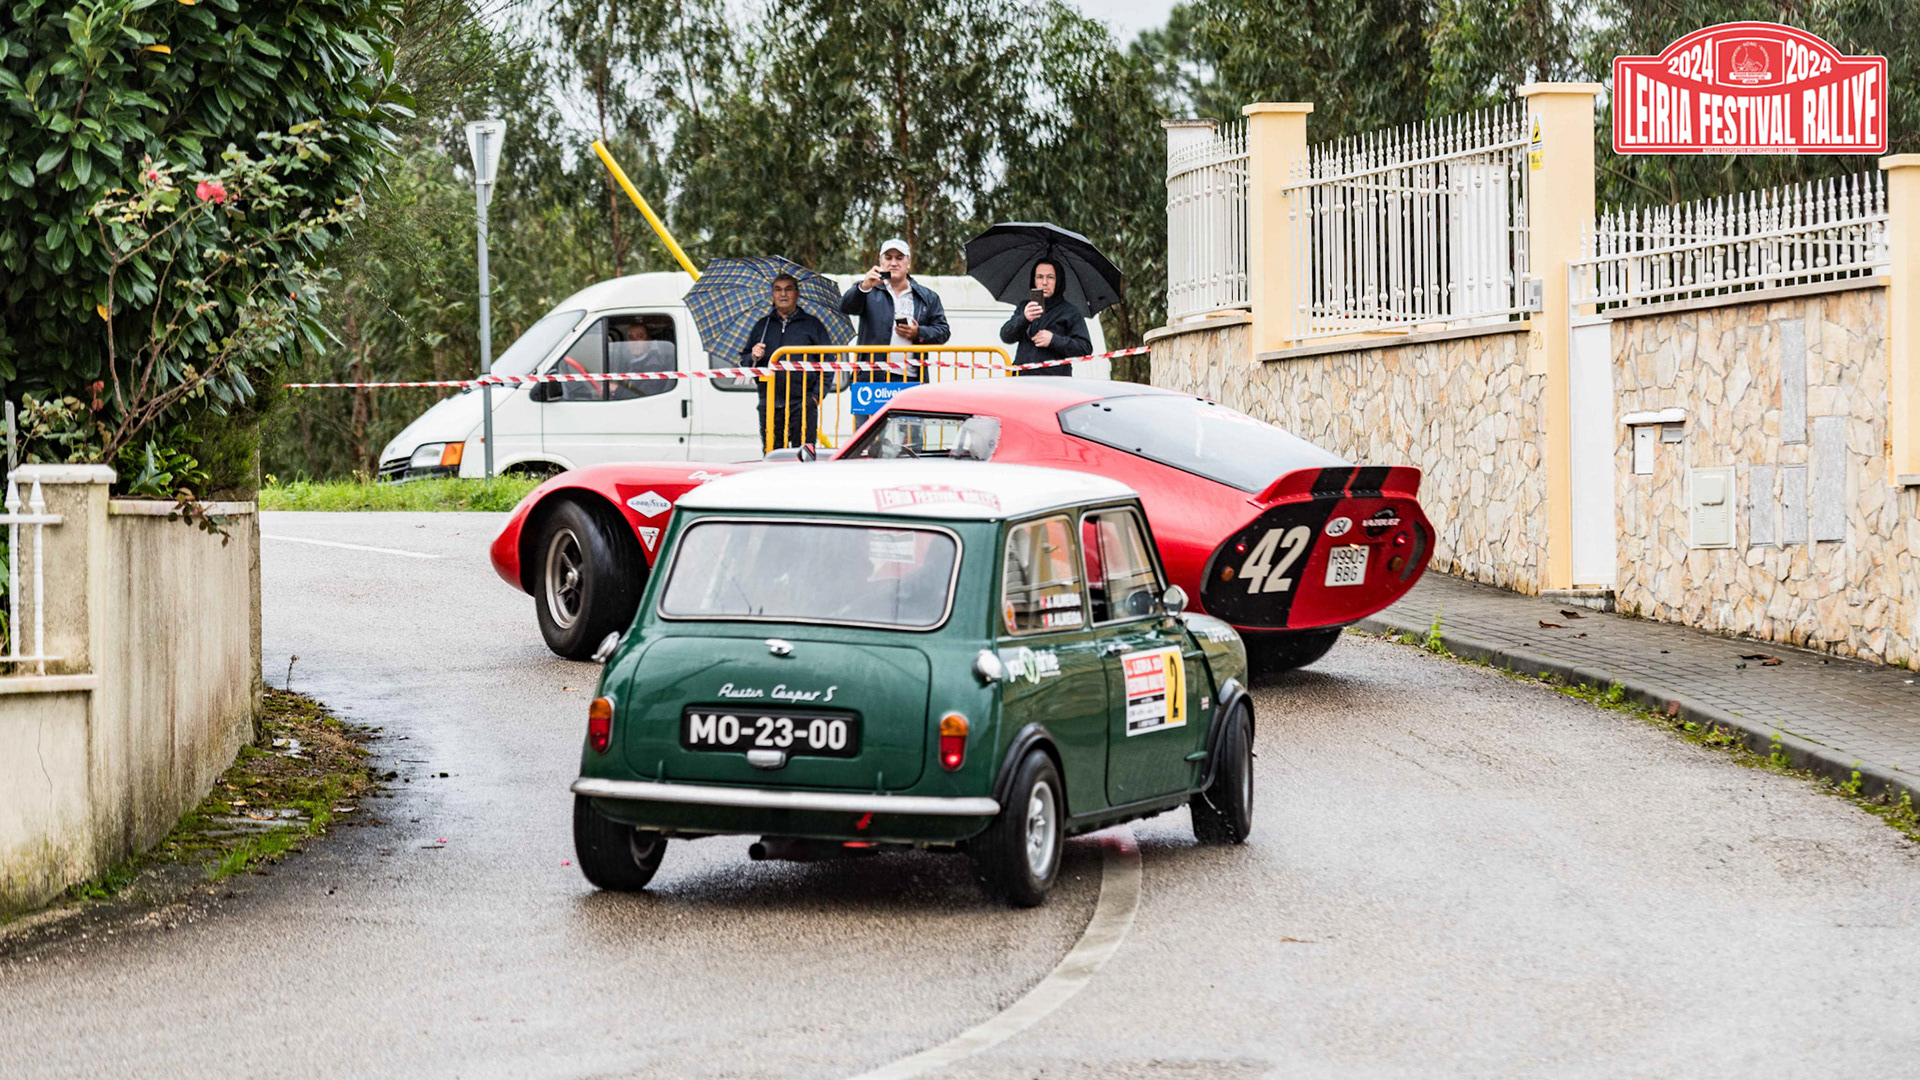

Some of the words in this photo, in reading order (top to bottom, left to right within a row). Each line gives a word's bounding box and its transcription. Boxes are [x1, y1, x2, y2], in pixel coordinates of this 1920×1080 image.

[1238, 525, 1311, 594] 42
[718, 682, 765, 698] Austin
[770, 684, 821, 703] Cooper
[823, 685, 838, 702] S
[1170, 655, 1179, 719] 2
[689, 714, 847, 750] MO-23-00
